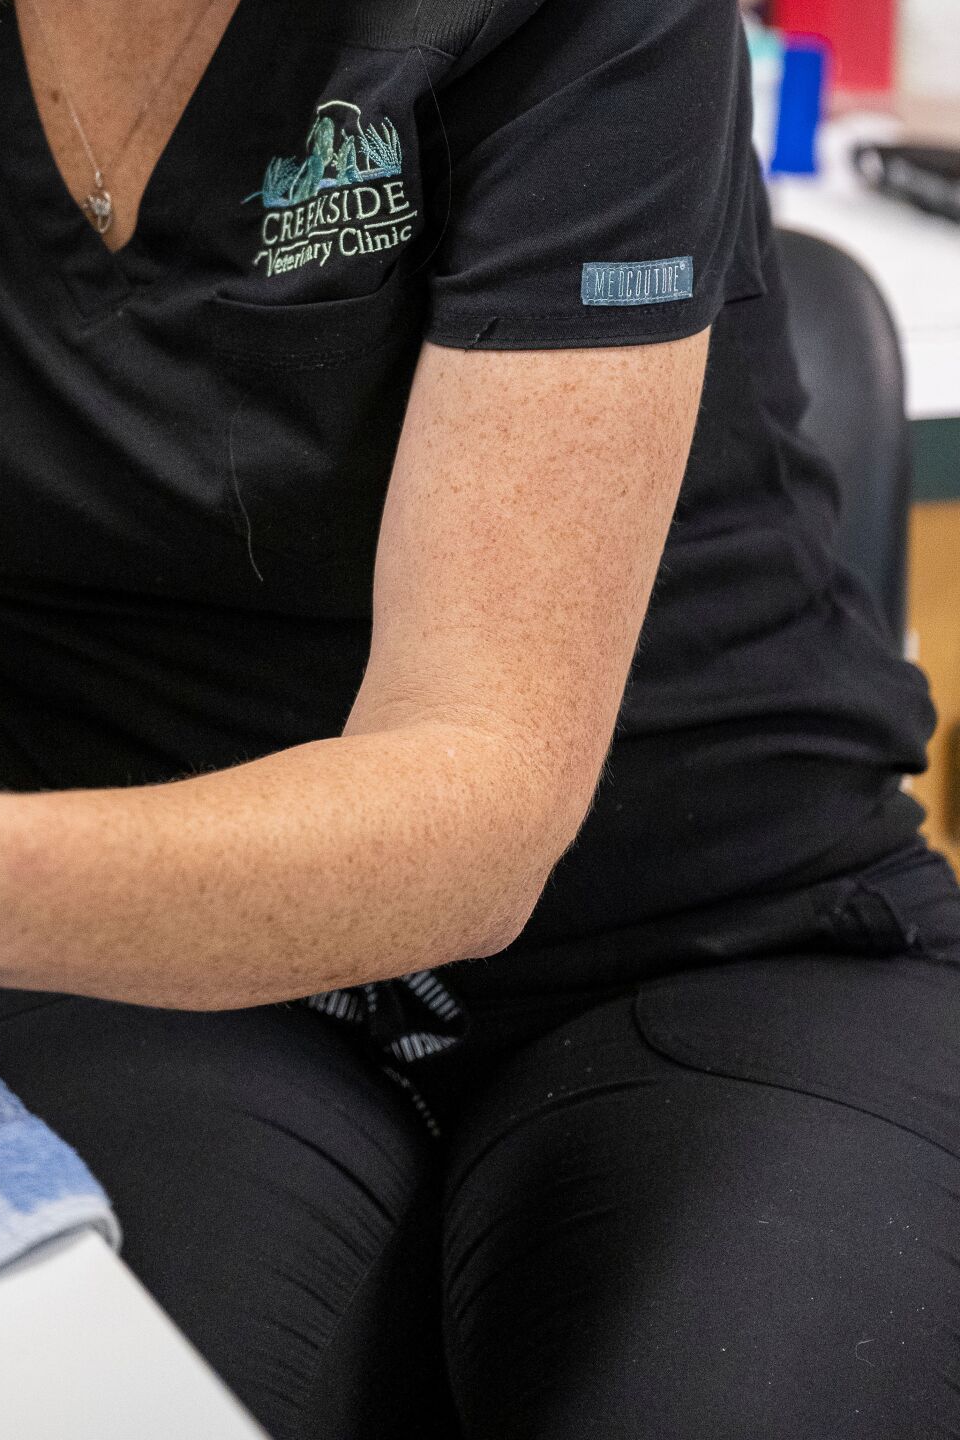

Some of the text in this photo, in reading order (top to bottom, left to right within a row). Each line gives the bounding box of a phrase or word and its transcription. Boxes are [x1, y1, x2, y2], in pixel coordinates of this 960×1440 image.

[262, 181, 410, 245] CREEKSIDE
[252, 225, 412, 277] Veterinary Clinic
